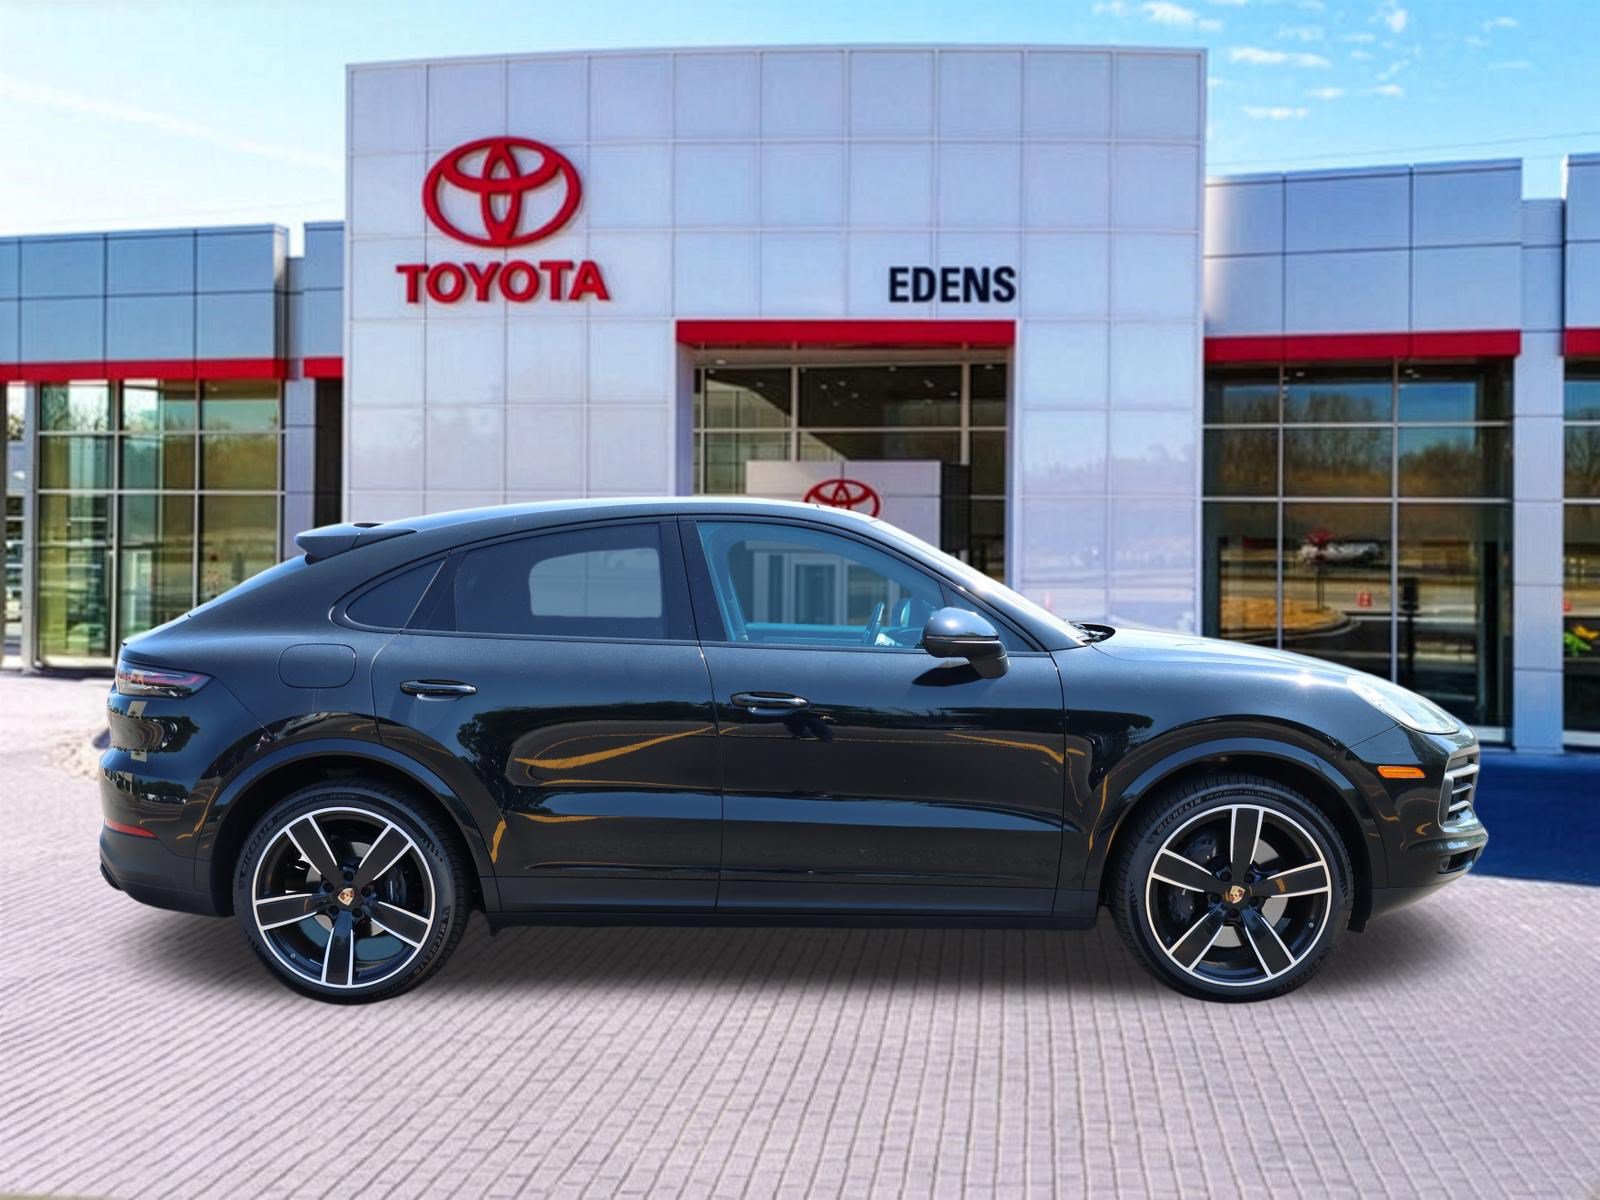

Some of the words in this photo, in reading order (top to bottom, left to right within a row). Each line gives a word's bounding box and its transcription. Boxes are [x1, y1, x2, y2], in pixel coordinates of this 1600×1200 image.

[396, 260, 610, 303] TOYOTA
[889, 265, 1016, 303] EDENS
[1156, 797, 1202, 833] MICHELIN
